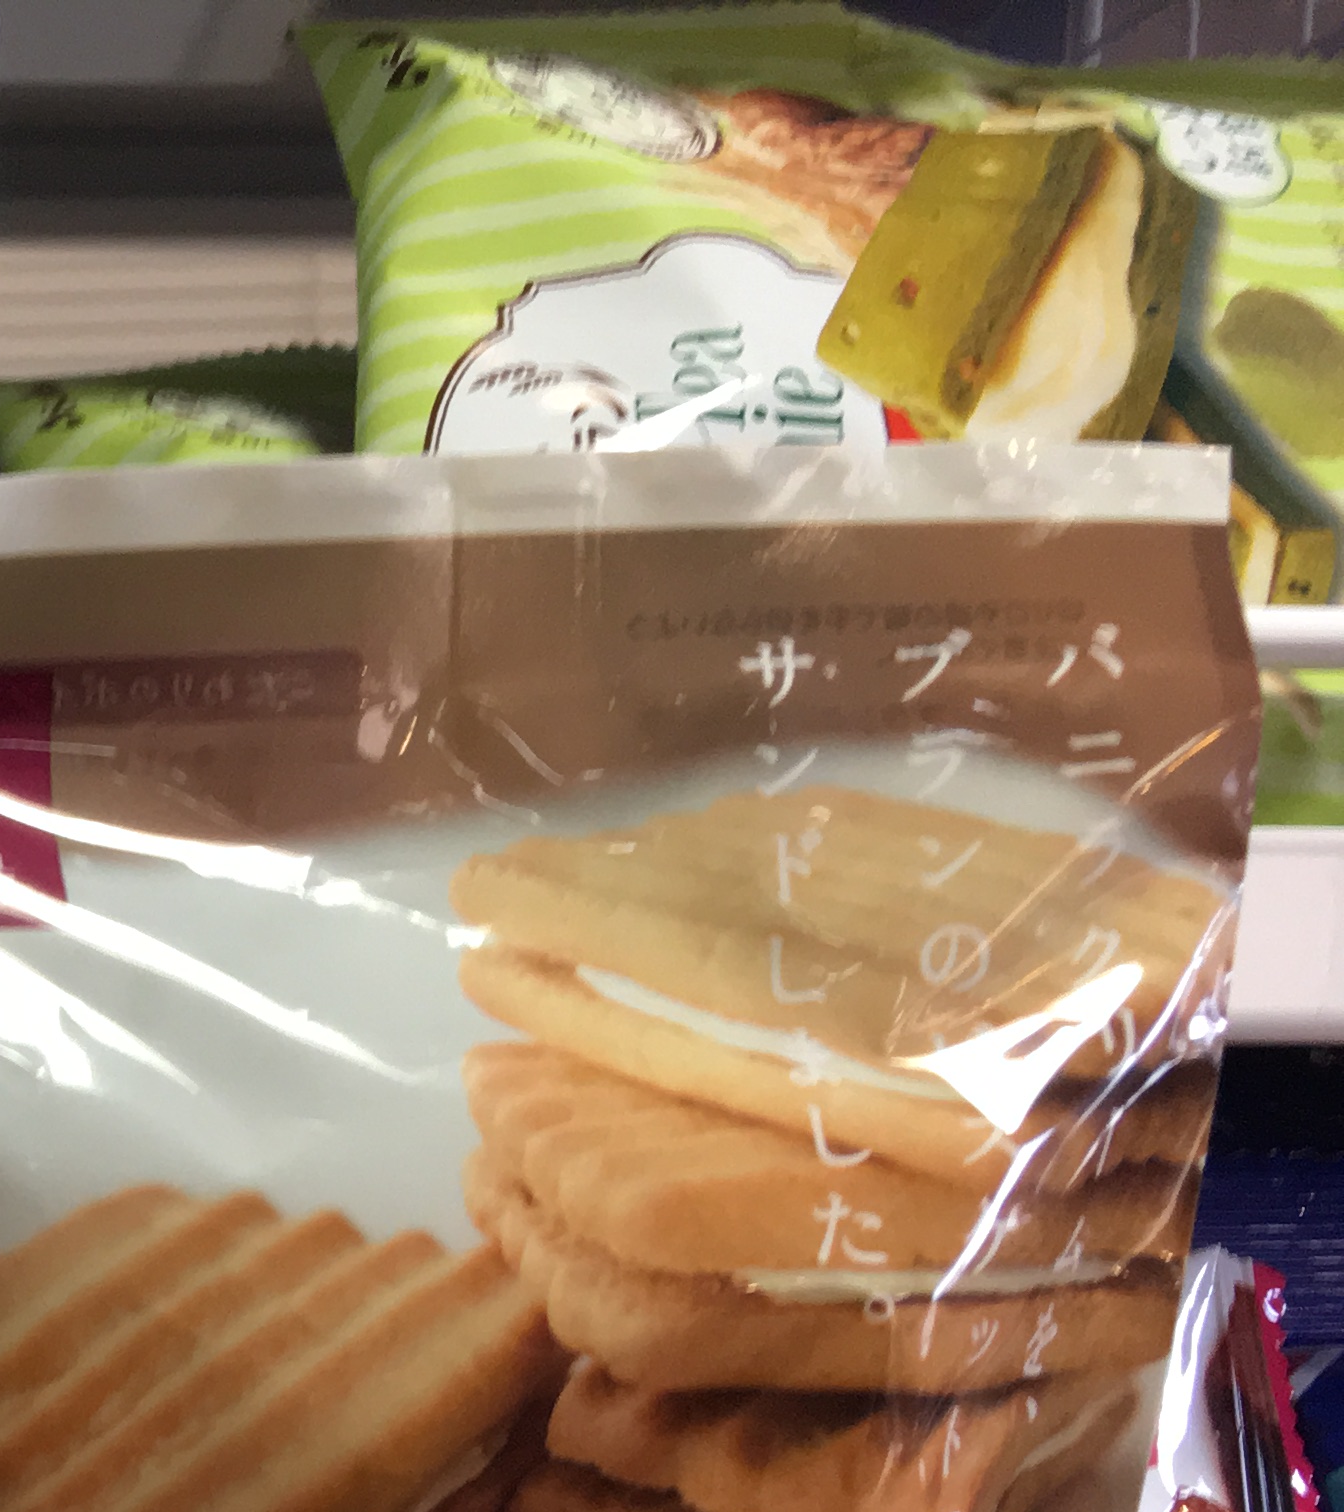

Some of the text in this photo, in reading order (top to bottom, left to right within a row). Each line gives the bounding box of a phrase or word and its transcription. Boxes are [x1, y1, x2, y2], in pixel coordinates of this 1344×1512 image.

[740, 636, 895, 1322] サンドしました。
